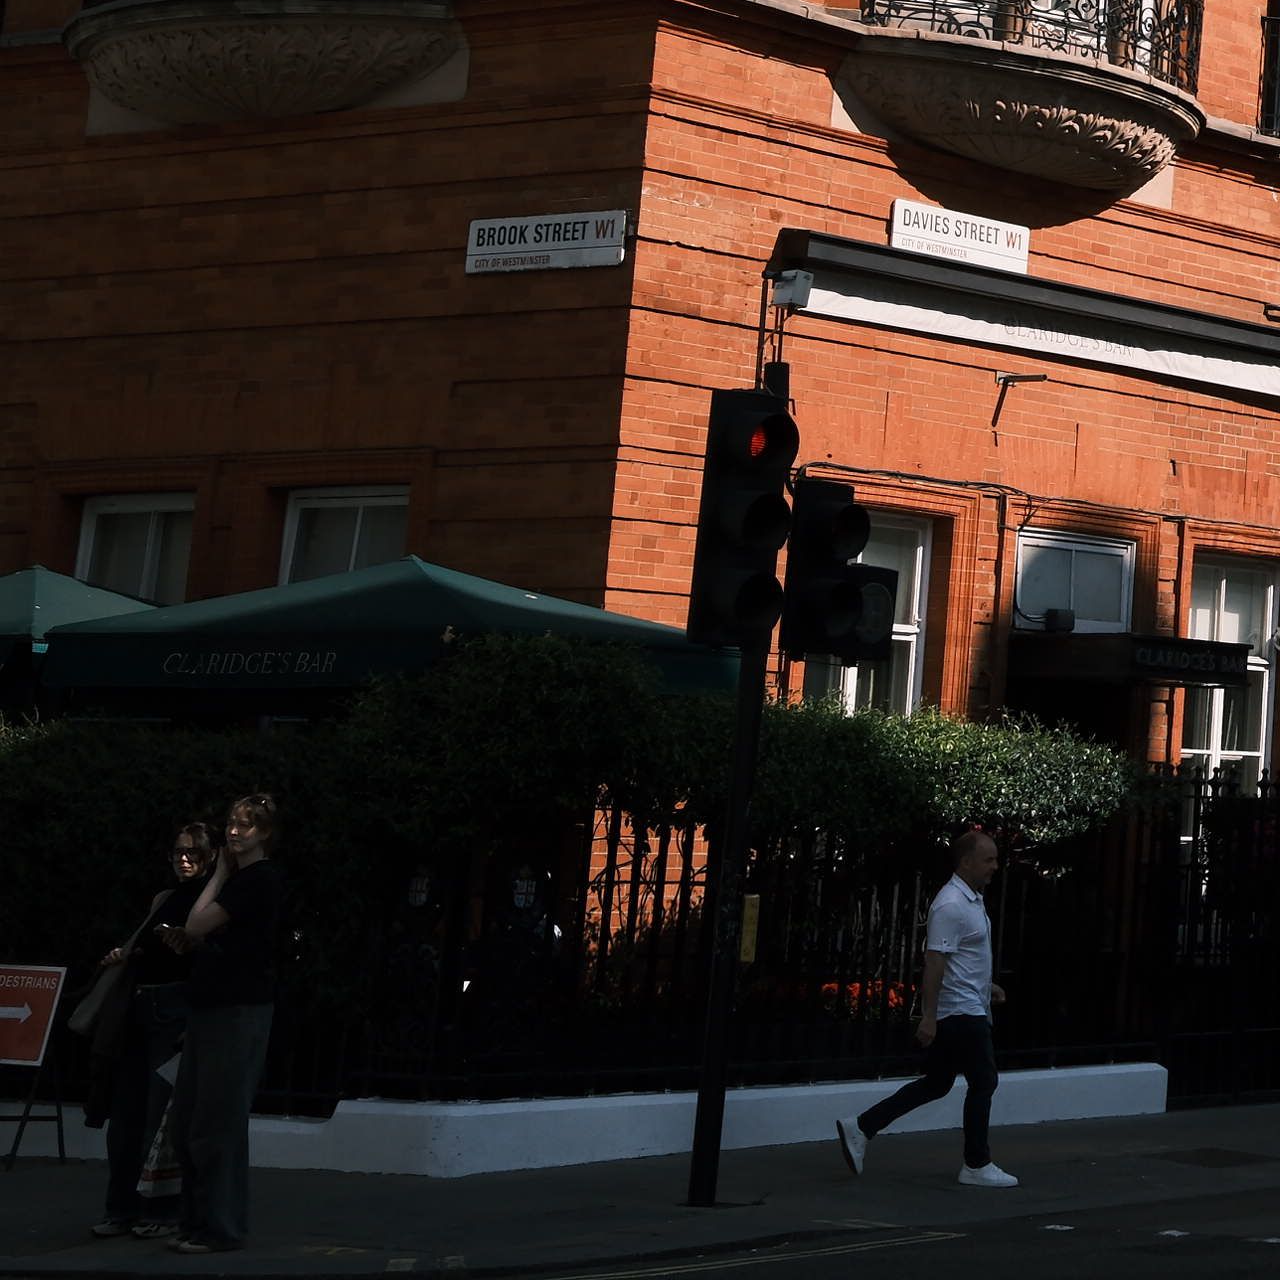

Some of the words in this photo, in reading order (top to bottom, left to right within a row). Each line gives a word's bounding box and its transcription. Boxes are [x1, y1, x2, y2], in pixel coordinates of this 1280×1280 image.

[476, 225, 529, 247] BROOK
[533, 221, 589, 244] STREET
[595, 218, 616, 240] W1
[903, 208, 950, 235] DAVIES
[954, 219, 1001, 245] STREET
[1005, 230, 1022, 251] W1
[901, 238, 915, 249] CITY
[917, 240, 925, 250] OF
[926, 243, 968, 259] WESTMINSTER
[474, 257, 490, 269] CITY
[491, 256, 501, 268] OF
[502, 254, 551, 268] WESTMINSTER
[162, 651, 290, 674] CLARIDGE'S
[294, 650, 337, 673] BAR
